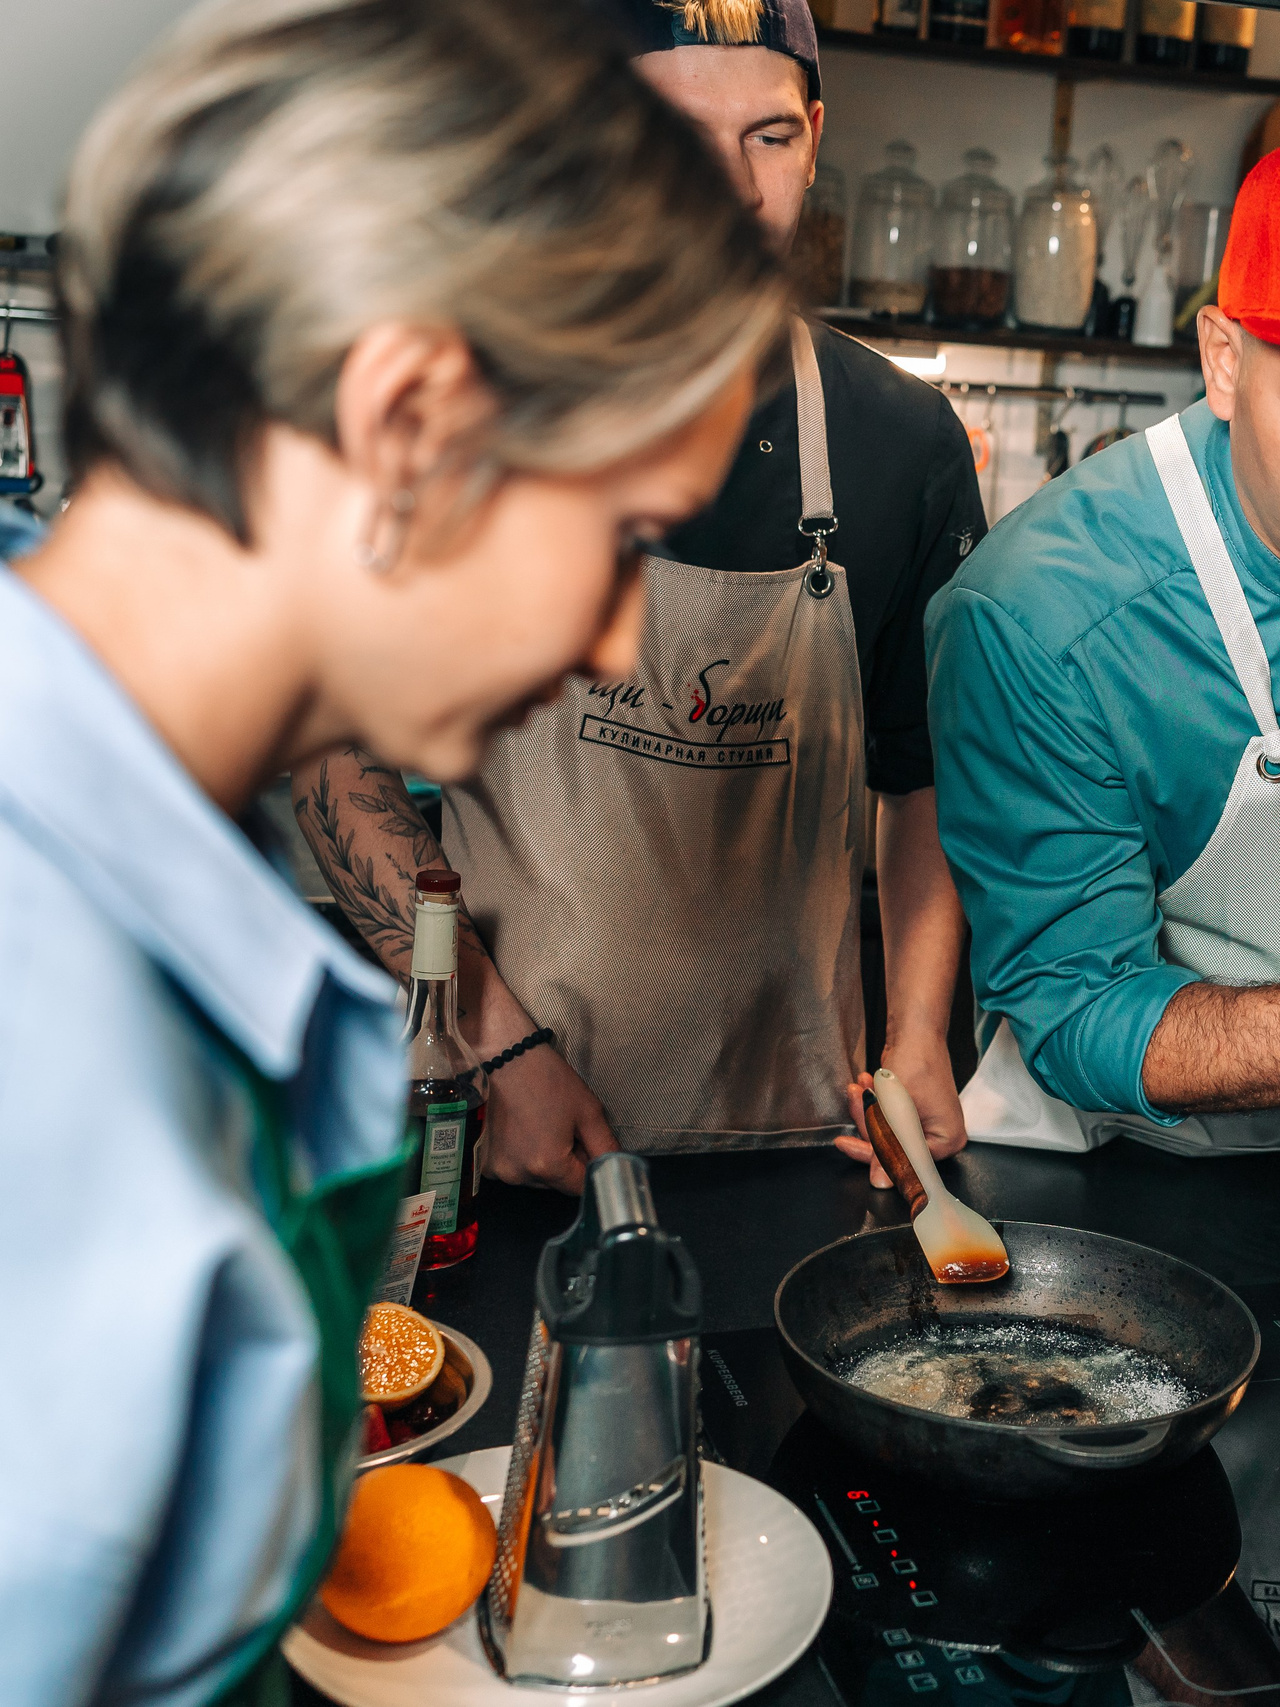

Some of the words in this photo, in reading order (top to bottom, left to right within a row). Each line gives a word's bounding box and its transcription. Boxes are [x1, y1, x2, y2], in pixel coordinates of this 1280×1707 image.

[687, 659, 788, 742] борщи
[600, 726, 706, 762] КУЛИНАРНАЯ
[717, 748, 773, 763] СТУДИЯ
[707, 1349, 748, 1407] KUPPERSBERG
